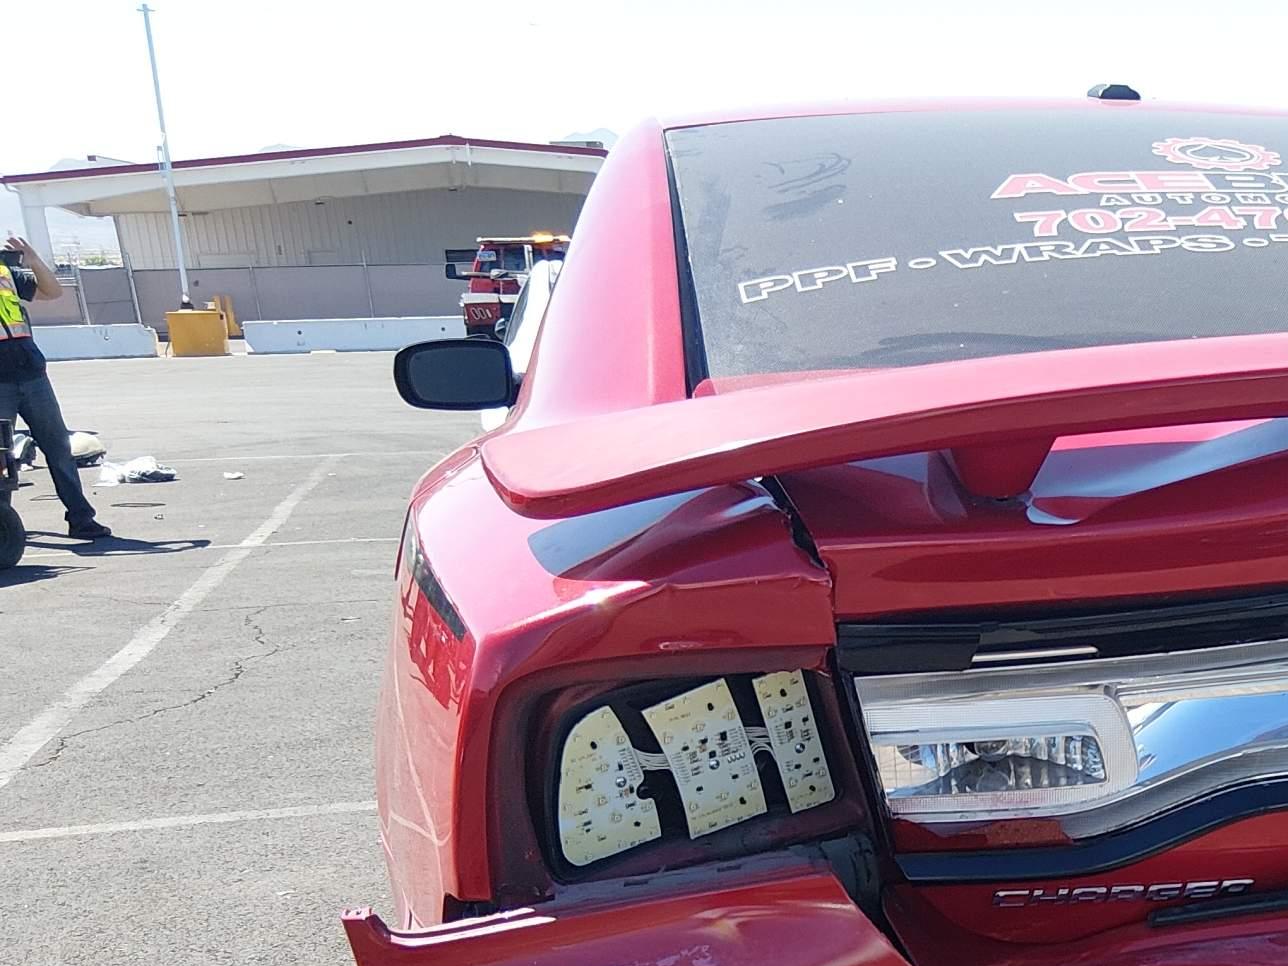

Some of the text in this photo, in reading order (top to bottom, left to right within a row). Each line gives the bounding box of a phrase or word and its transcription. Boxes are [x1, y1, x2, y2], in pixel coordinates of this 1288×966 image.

[738, 256, 898, 303] PPF
[938, 235, 1235, 267] WRAPS
[994, 879, 1255, 907] CHARGER
